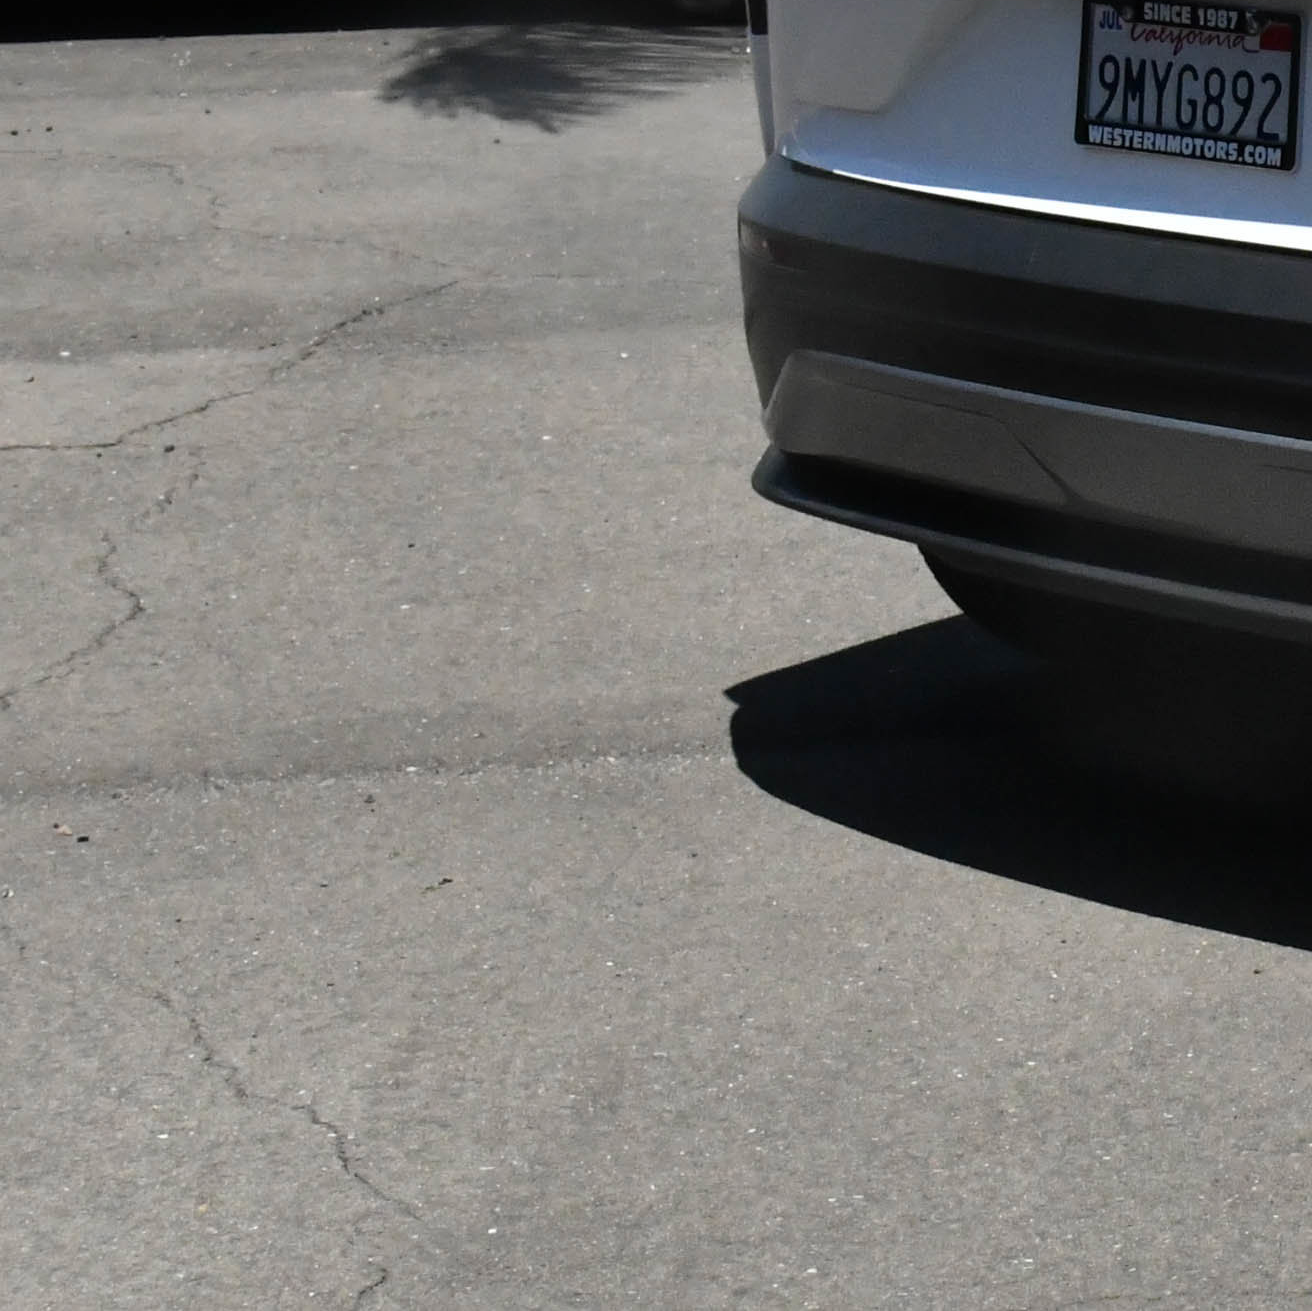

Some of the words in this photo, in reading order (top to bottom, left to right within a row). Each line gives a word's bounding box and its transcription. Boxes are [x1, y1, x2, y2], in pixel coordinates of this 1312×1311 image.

[1143, 1, 1191, 25] SINCE
[1197, 7, 1239, 30] 1987
[1095, 53, 1282, 141] 9MYG892
[1087, 124, 1282, 168] WESTERNMOTORS.COM
